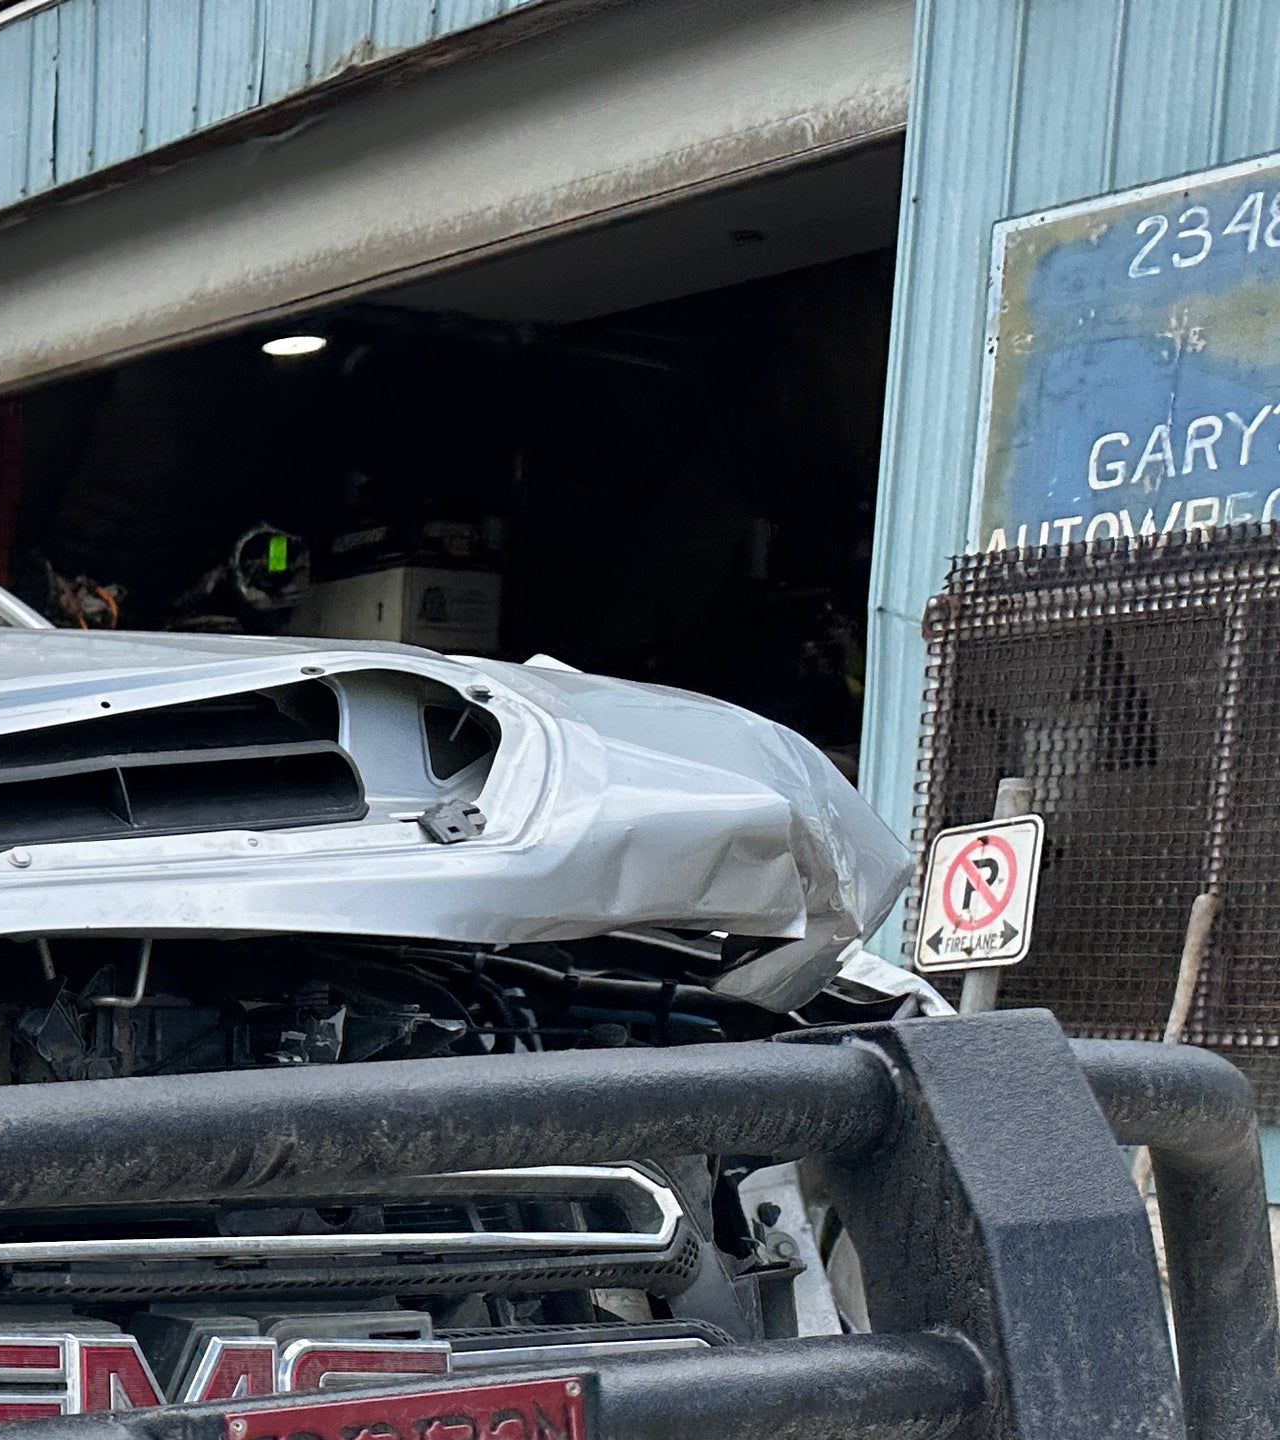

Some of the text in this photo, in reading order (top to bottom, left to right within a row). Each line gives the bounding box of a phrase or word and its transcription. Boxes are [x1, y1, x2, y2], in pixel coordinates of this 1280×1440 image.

[1087, 404, 1280, 490] GARY
[944, 932, 999, 954] FIRE LANE
